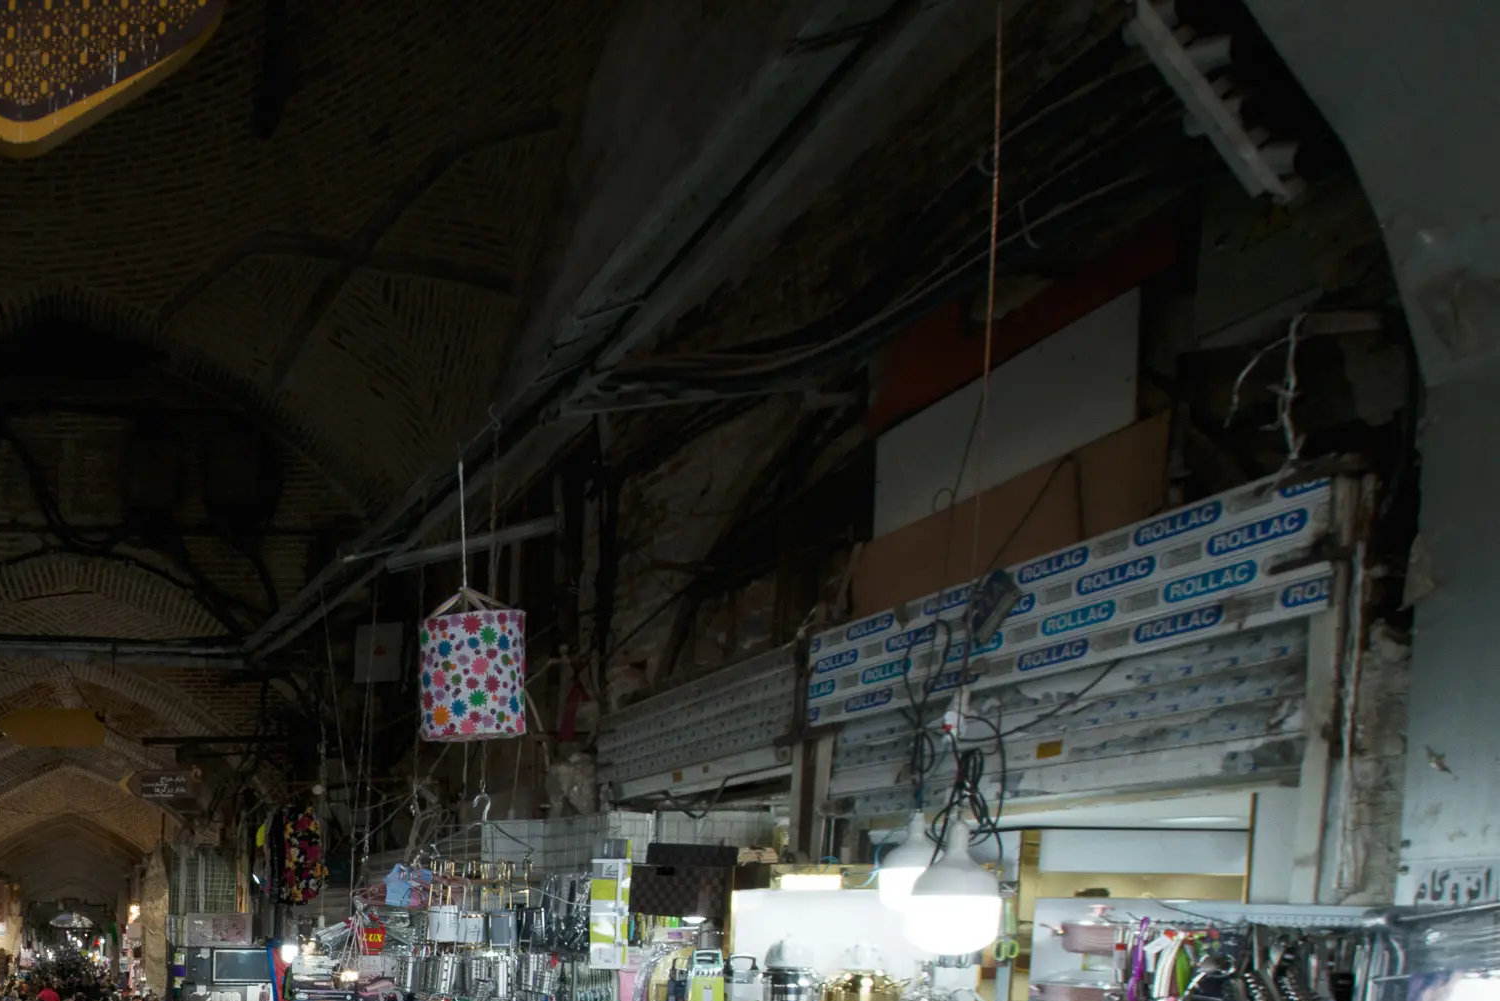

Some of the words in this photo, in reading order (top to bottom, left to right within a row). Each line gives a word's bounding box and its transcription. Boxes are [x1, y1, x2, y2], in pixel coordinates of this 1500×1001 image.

[1021, 549, 1086, 582] ROLLAC
[1138, 503, 1216, 544] ROLLAC
[1080, 559, 1149, 593] ROLLAC
[1212, 513, 1301, 553] ROLLAC
[1045, 603, 1111, 633] ROLLAC
[1168, 564, 1250, 600] ROLLAC
[1021, 641, 1084, 669] ROLLAC
[1138, 609, 1216, 641] ROLLAC
[362, 933, 383, 943] LUX
